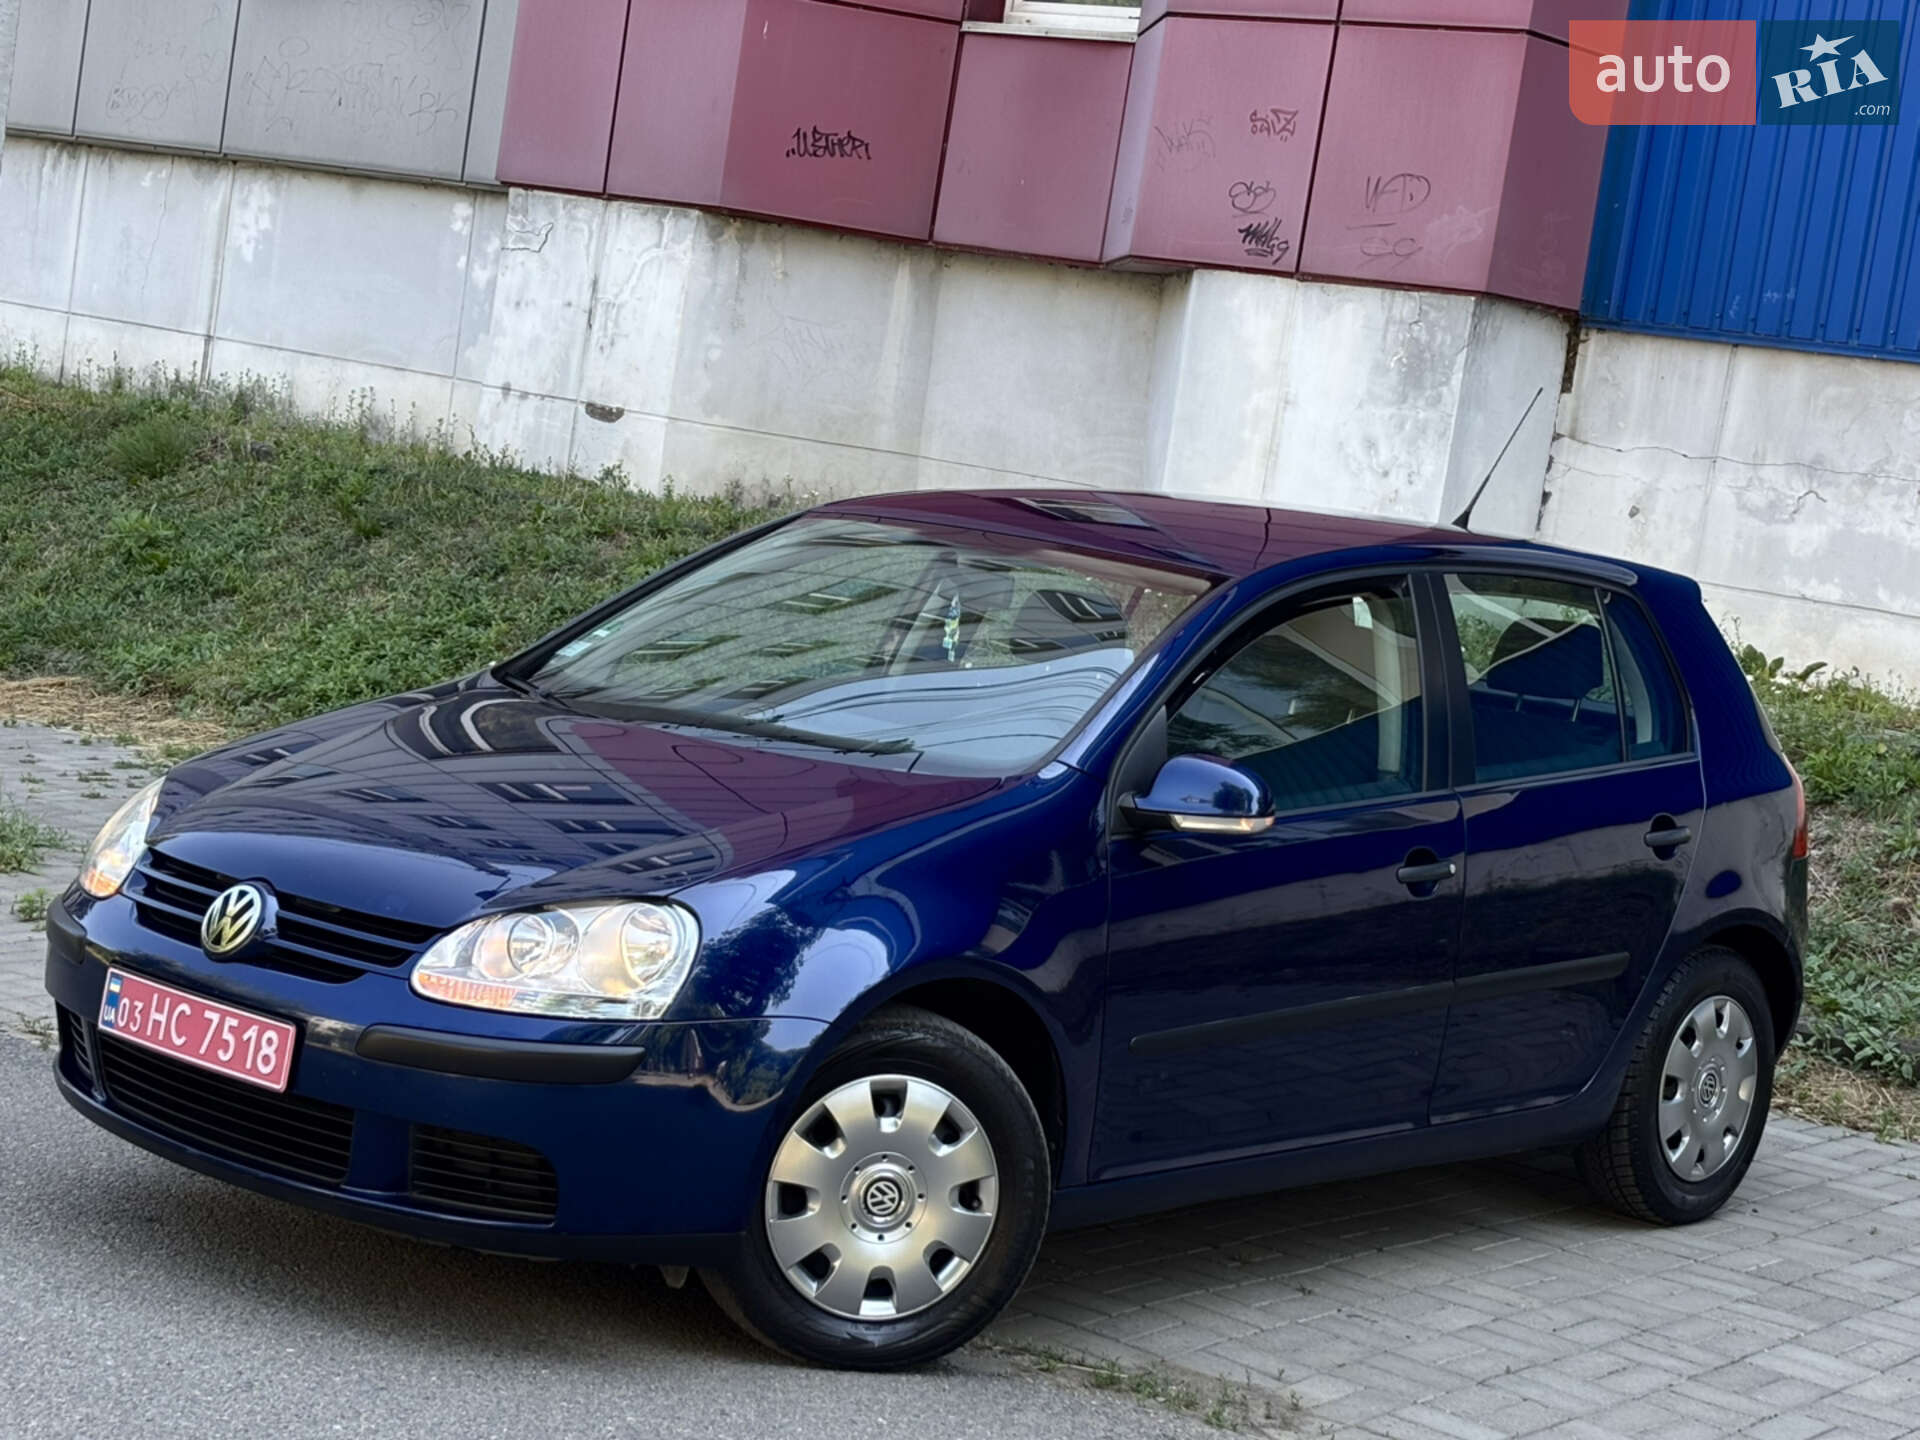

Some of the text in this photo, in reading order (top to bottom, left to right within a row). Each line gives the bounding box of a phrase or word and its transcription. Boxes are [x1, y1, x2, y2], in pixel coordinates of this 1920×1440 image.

[103, 1006, 116, 1024] UA
[117, 993, 280, 1075] 03 HC 7518
